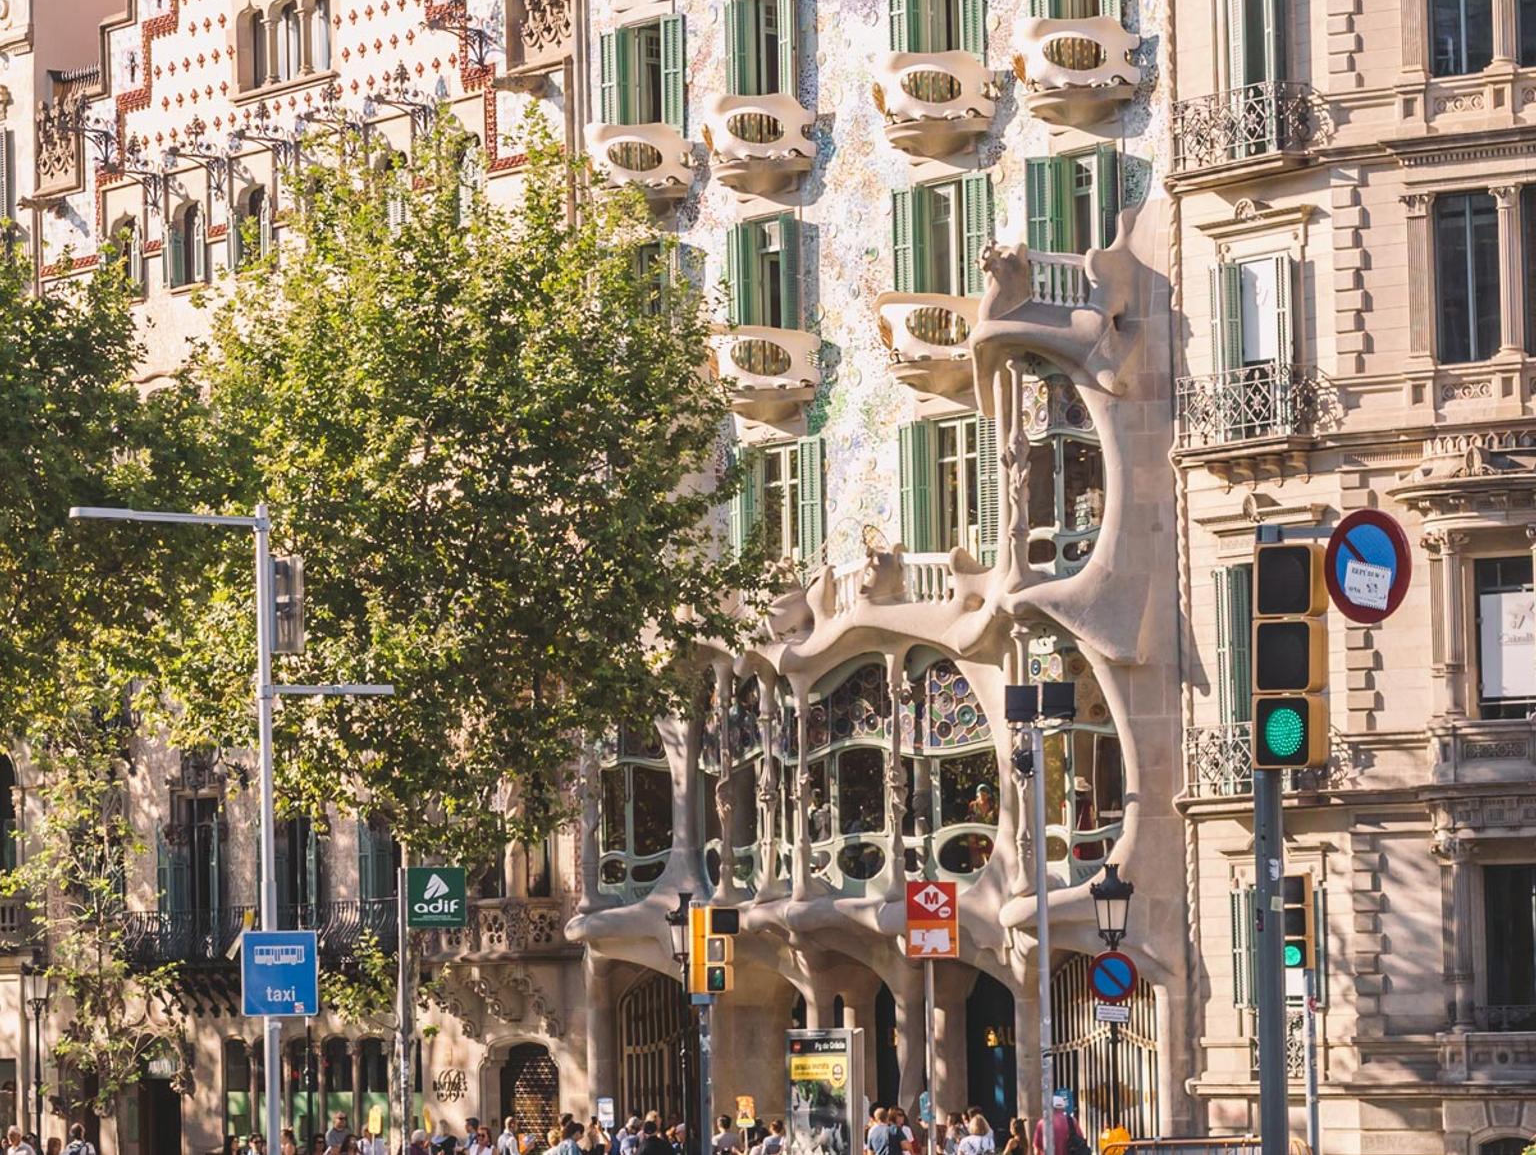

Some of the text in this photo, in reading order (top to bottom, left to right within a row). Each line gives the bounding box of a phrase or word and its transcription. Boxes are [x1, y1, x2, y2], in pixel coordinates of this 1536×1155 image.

[414, 898, 460, 914] adif
[925, 892, 939, 905] M
[266, 986, 296, 1002] taxi
